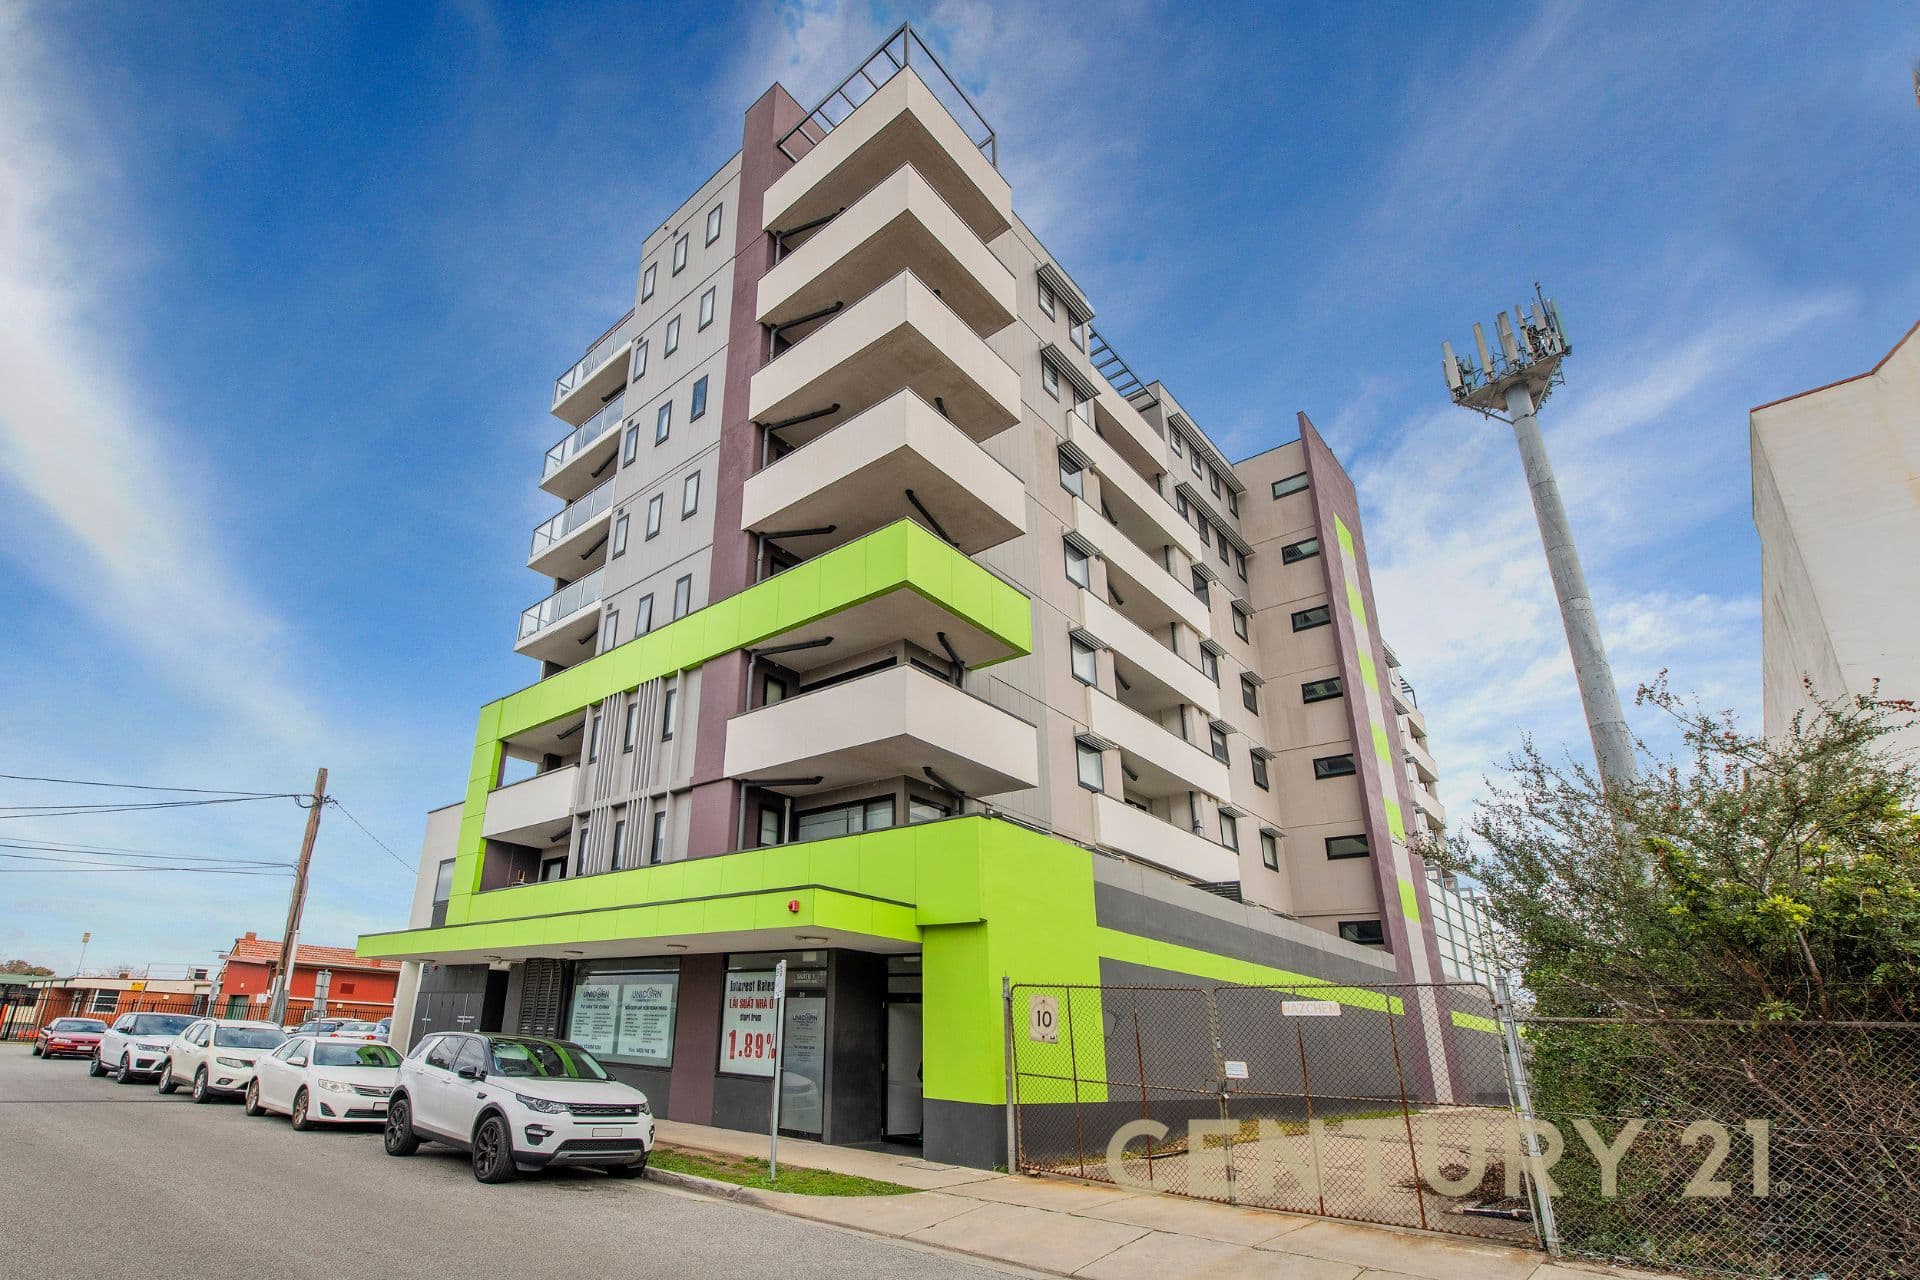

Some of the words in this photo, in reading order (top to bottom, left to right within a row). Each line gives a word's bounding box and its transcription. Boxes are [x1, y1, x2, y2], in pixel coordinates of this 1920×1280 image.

[730, 980, 755, 992] Interest
[757, 980, 775, 992] Rates
[633, 988, 662, 998] UNICORN
[1283, 1003, 1340, 1014] HAZCHEM
[740, 1013, 750, 1022] start
[751, 1013, 762, 1022] from
[1036, 1010, 1052, 1028] 10
[729, 1030, 776, 1060] 1.89%
